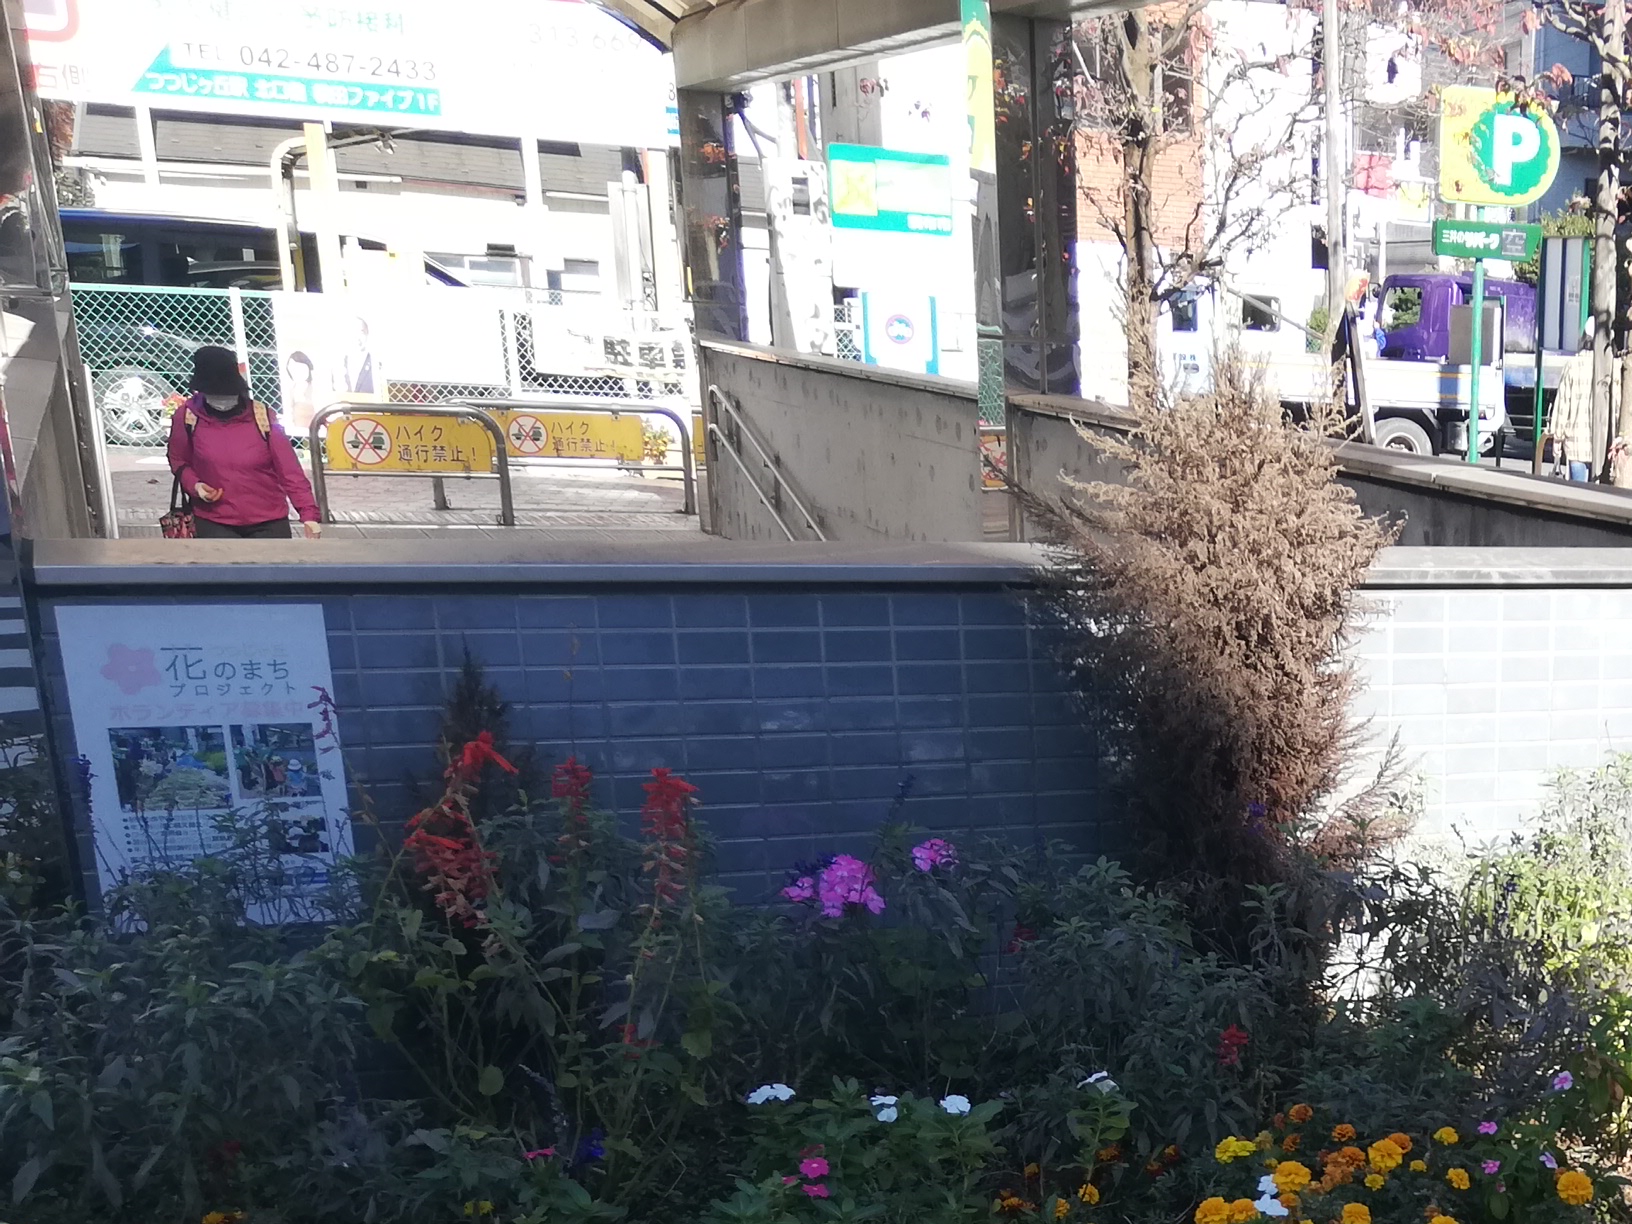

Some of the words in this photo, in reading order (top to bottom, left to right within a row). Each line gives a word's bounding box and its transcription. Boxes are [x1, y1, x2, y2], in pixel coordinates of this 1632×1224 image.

[239, 45, 438, 81] 042-487-2433
[1493, 113, 1541, 186] P
[160, 646, 290, 681] 花のまち
[169, 682, 297, 698] プロジェクト
